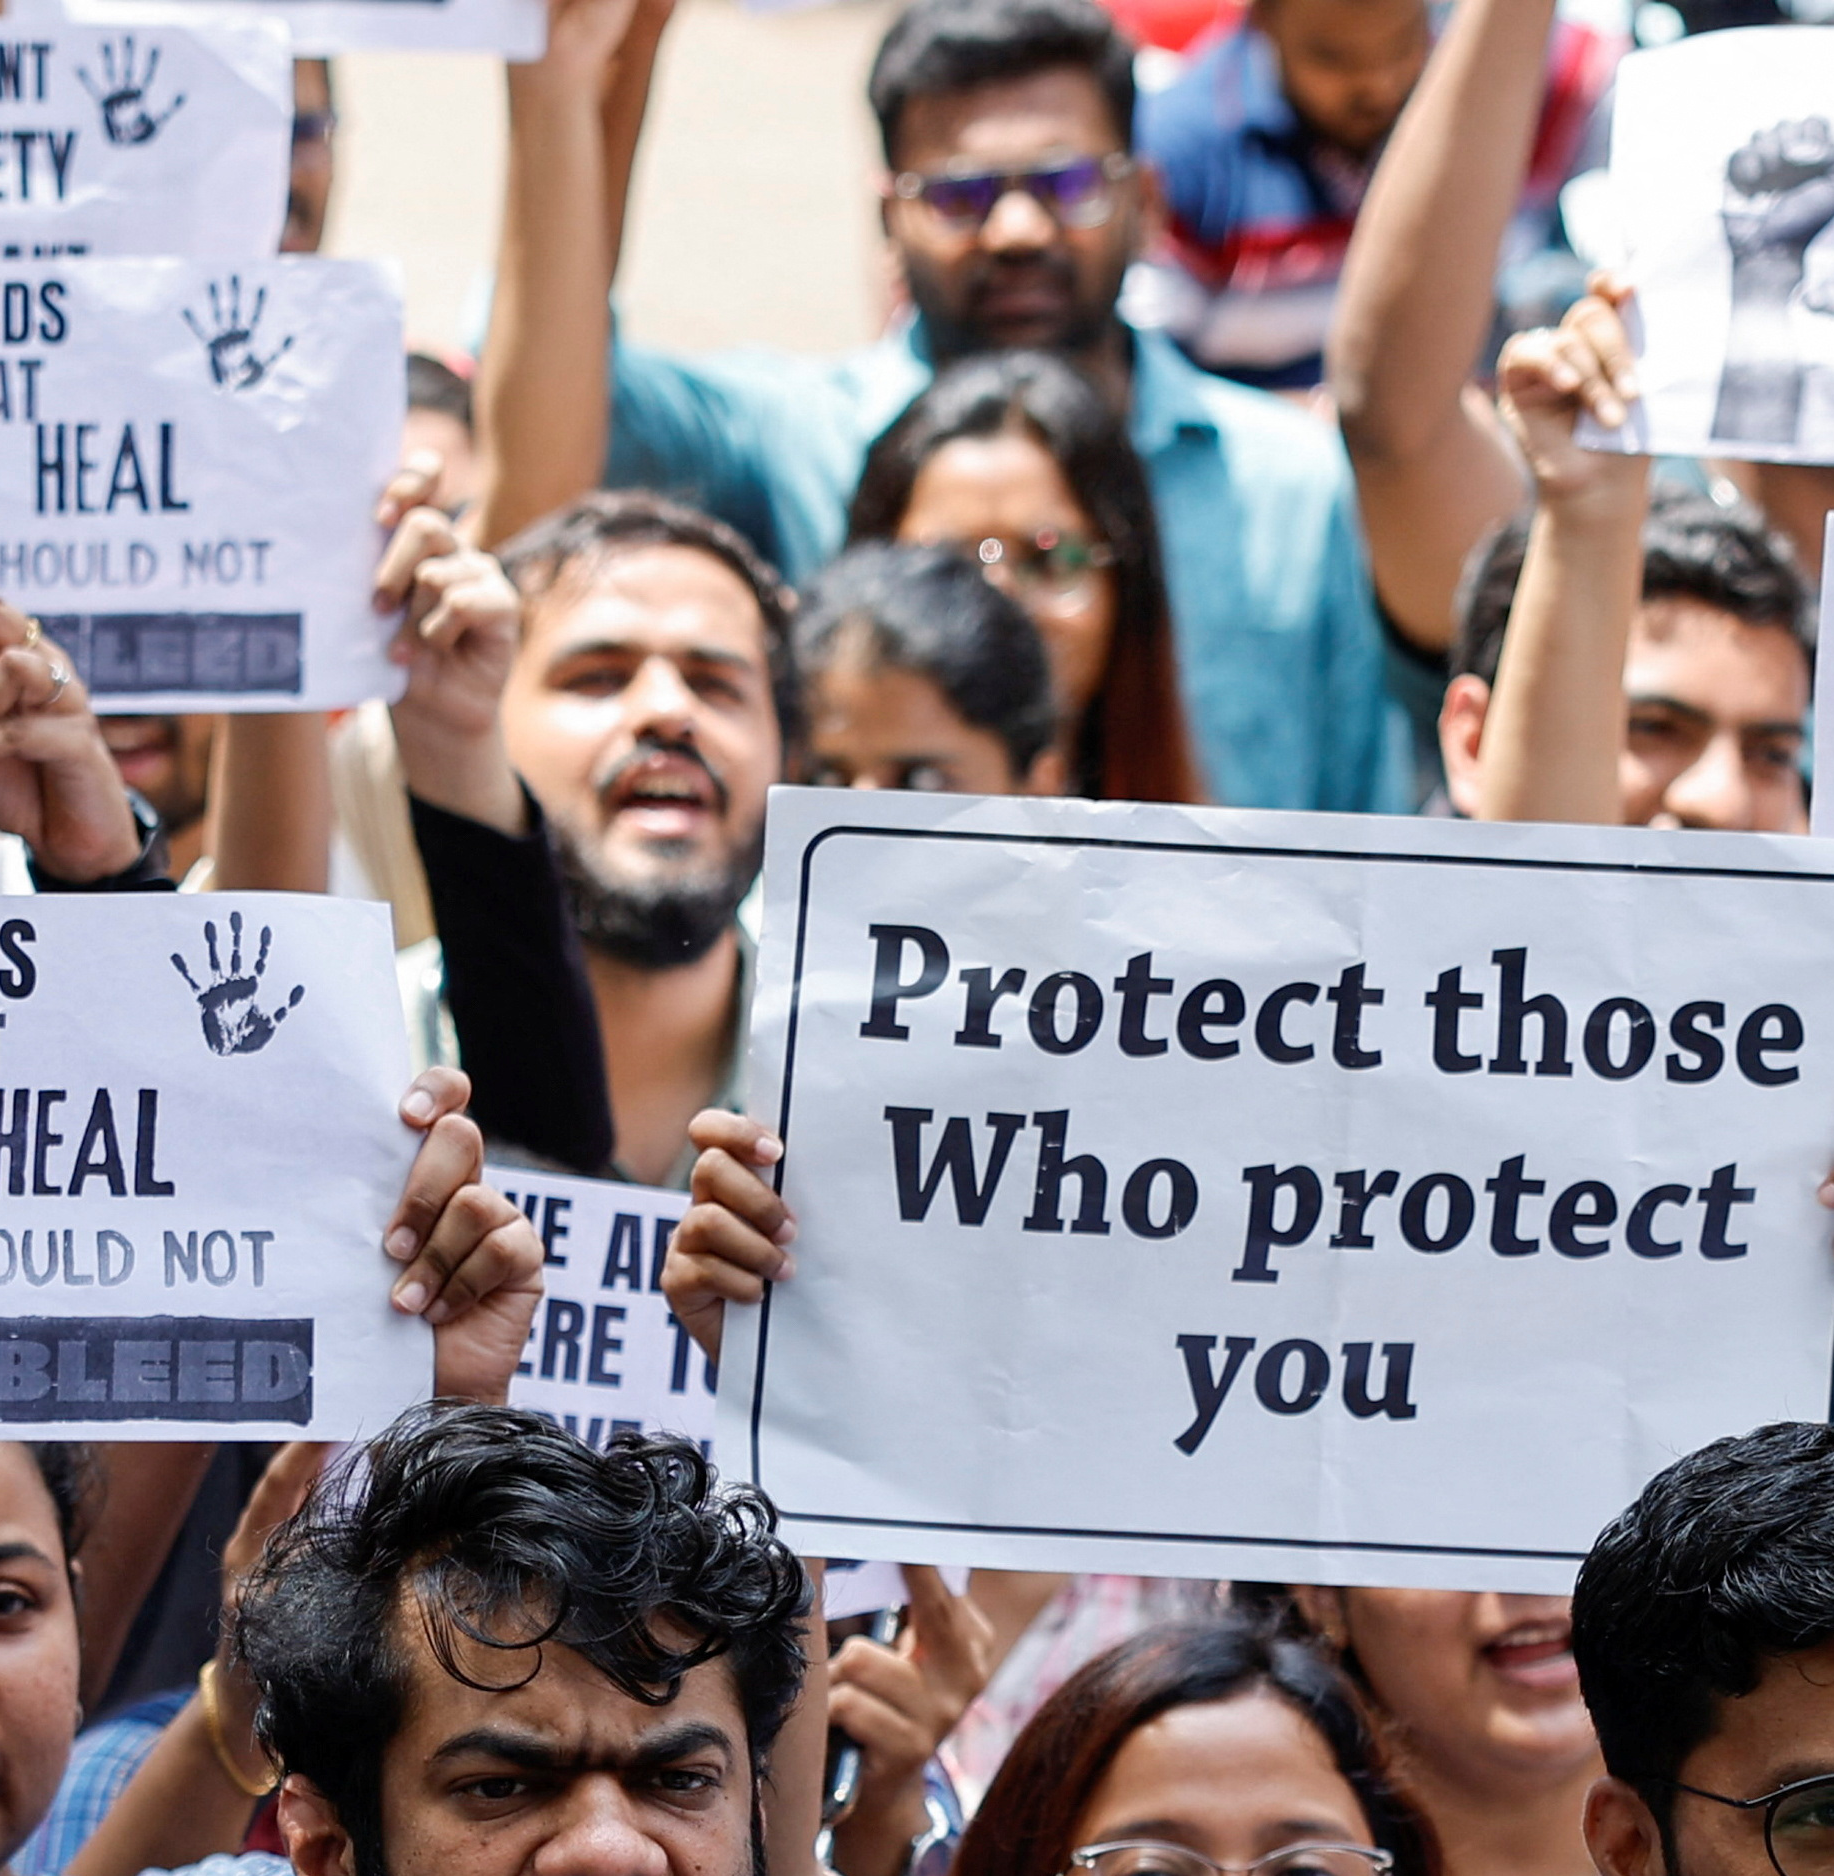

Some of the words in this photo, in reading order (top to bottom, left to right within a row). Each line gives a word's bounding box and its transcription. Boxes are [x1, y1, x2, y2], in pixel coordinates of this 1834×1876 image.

[36, 424, 190, 515] HEAL
[183, 542, 274, 584] NOT
[859, 923, 1384, 1071] Protect
[1425, 946, 1804, 1086] those
[883, 1105, 1199, 1239] Who
[1232, 1153, 1756, 1284] protect
[163, 1230, 274, 1288] NOT
[1173, 1333, 1417, 1456] you
